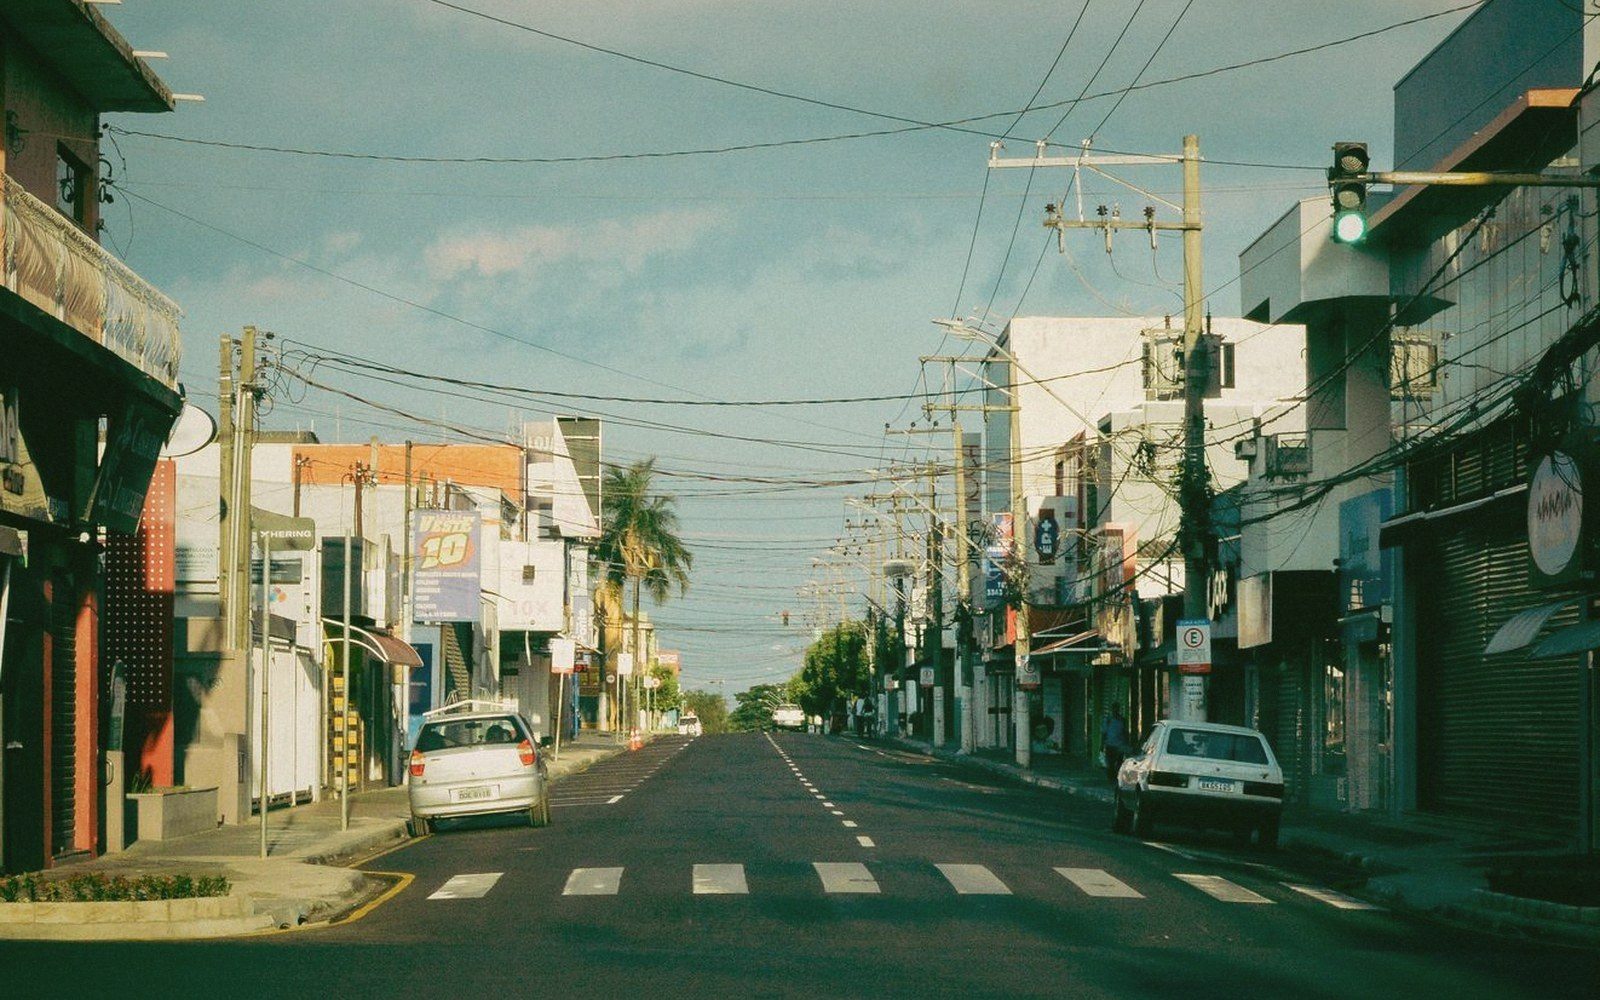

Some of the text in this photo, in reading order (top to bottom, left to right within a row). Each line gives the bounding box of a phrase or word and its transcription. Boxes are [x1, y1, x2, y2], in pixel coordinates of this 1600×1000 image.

[270, 530, 312, 538] HERING
[420, 533, 469, 569] 10
[1190, 631, 1198, 644] E
